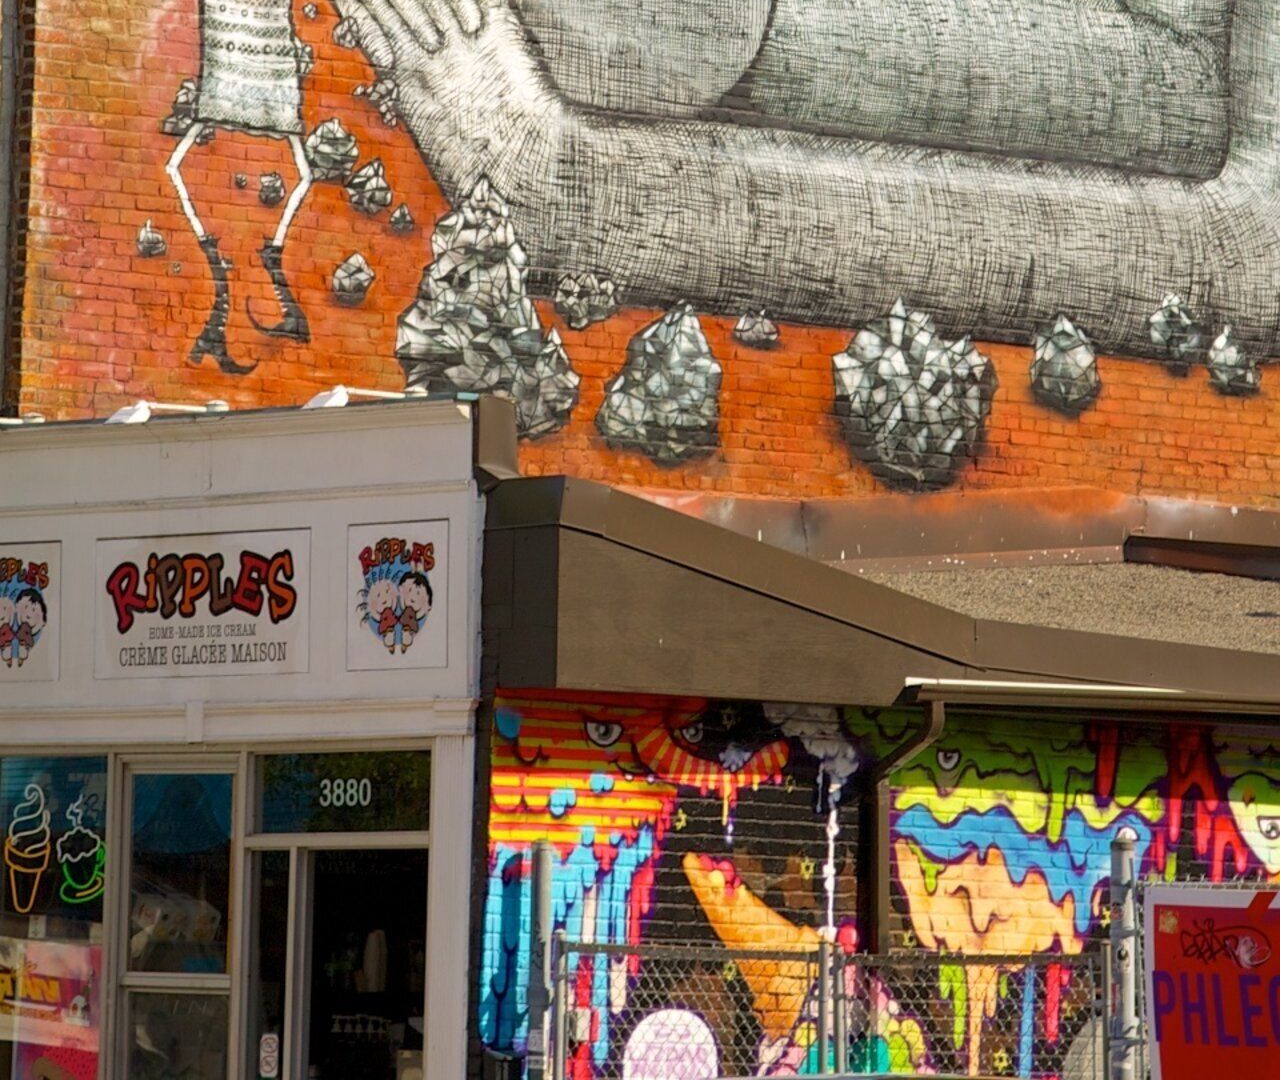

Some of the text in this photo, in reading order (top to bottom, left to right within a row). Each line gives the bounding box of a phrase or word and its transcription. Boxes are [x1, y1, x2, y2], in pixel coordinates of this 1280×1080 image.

[206, 625, 222, 637] ICE
[224, 624, 256, 637] CREAM
[119, 640, 288, 667] CRÈME GLACÉE MAISON
[319, 778, 372, 807] 3880
